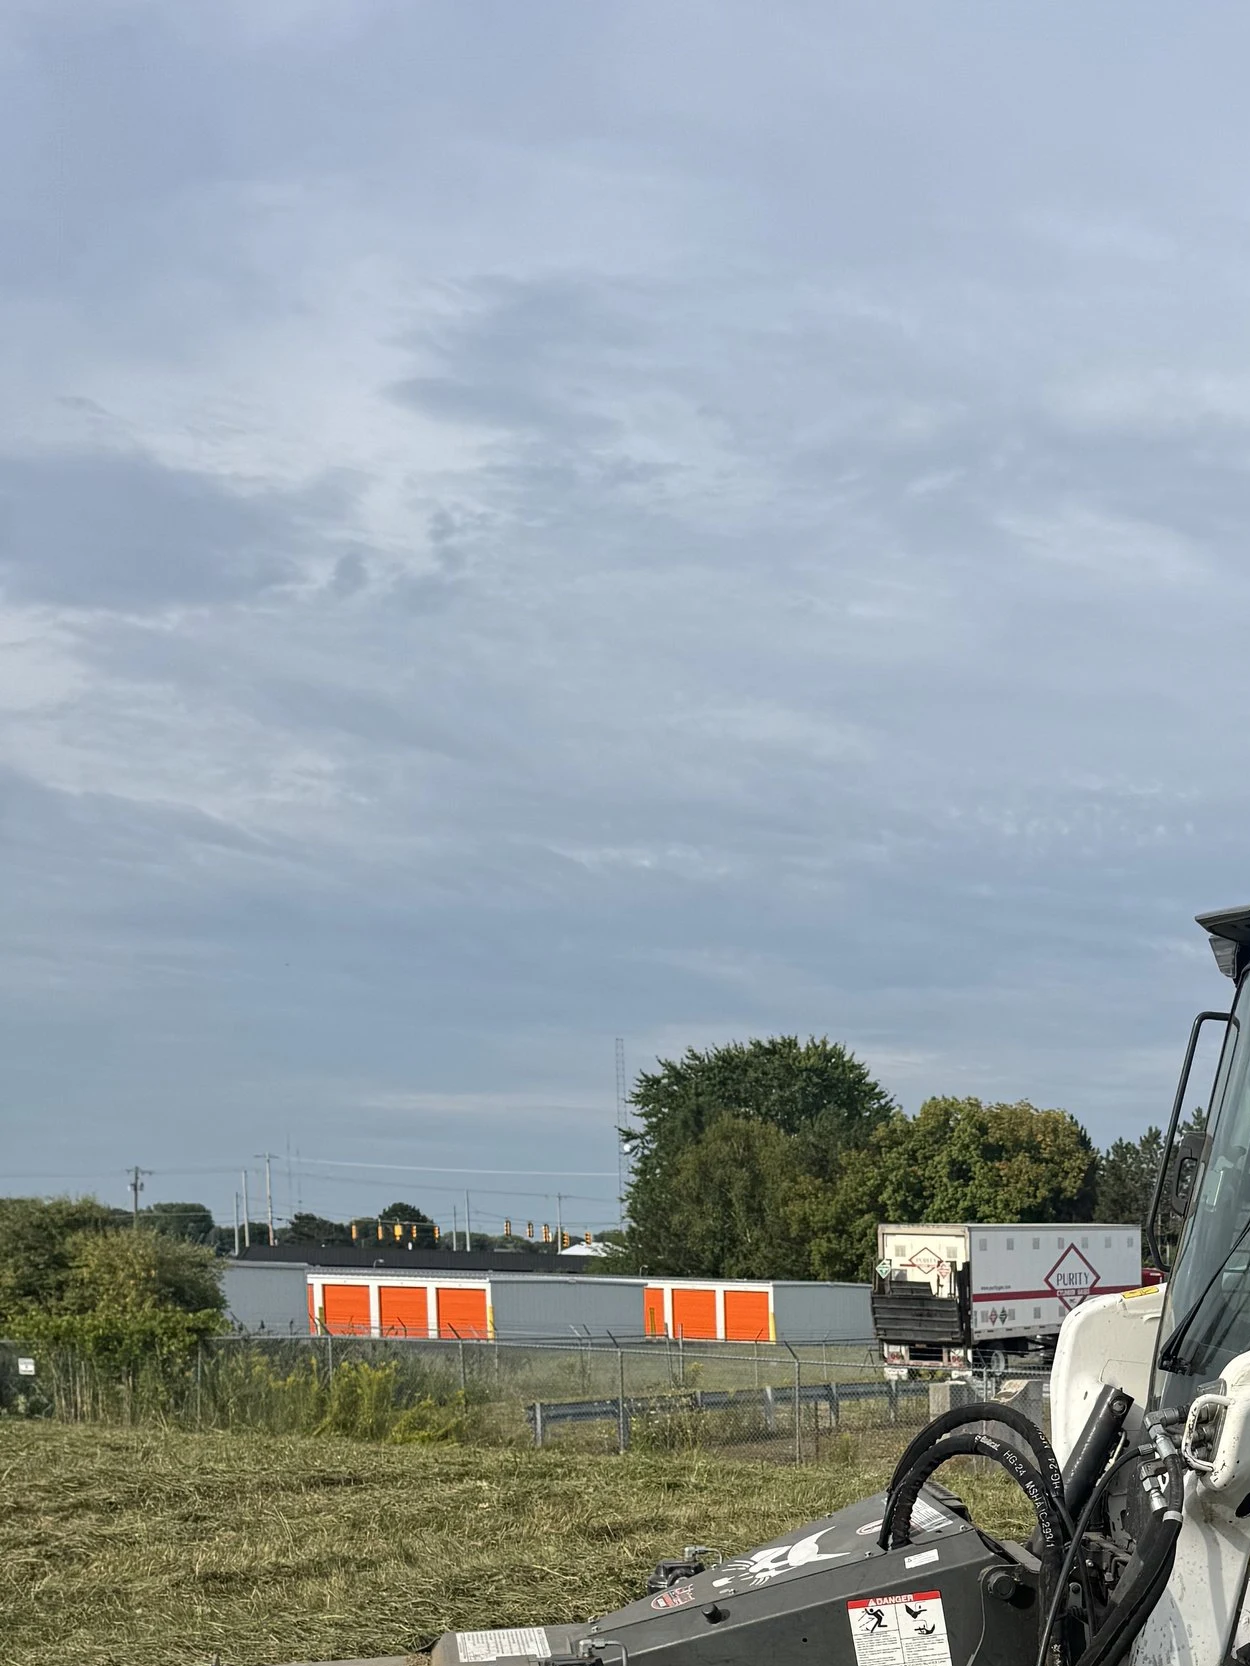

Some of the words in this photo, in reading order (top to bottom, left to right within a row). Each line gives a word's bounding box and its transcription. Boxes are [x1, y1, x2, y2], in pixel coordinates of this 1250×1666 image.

[1056, 1272, 1090, 1286] PURITY
[1003, 1449, 1027, 1478] HG-24
[1024, 1479, 1045, 1509] MSHA
[875, 1594, 914, 1606] DANGER
